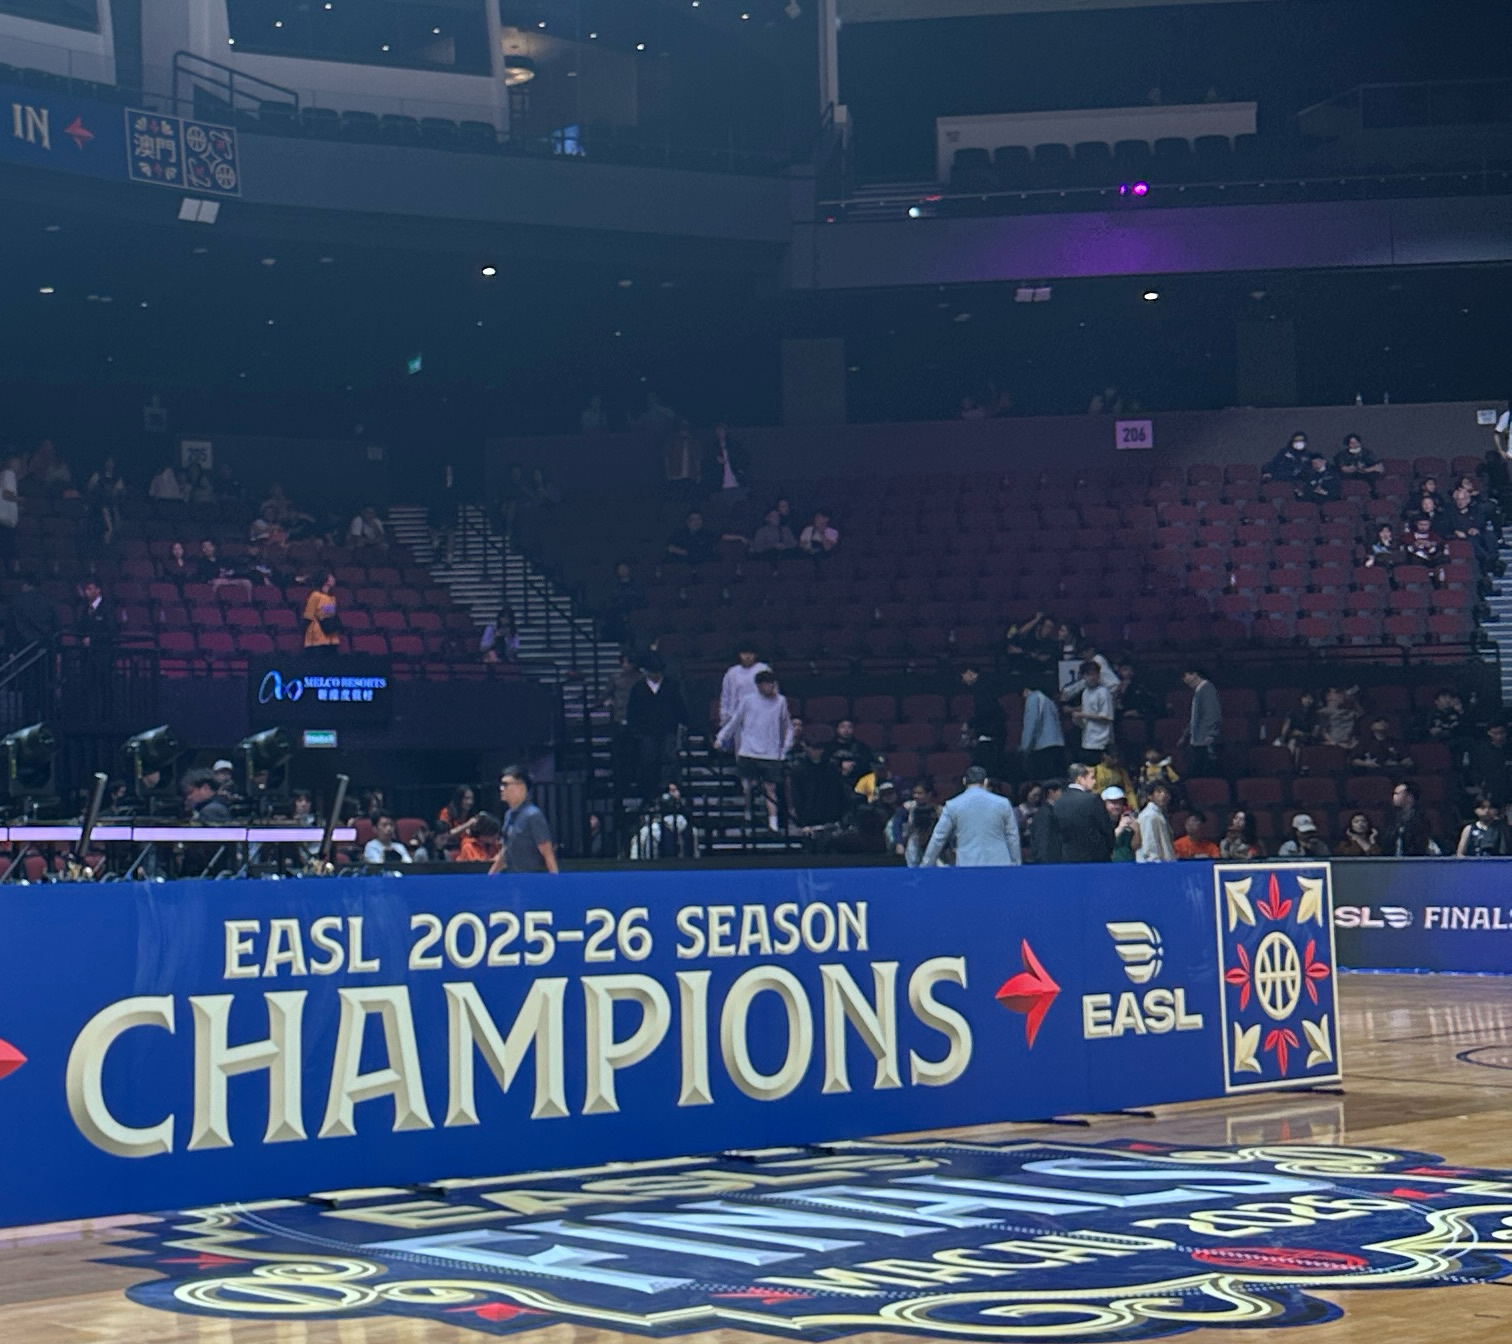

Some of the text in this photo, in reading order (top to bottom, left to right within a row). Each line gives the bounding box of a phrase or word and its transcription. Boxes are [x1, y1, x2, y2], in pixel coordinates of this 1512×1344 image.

[12, 103, 51, 150] IN
[134, 134, 176, 162] 澳門
[1122, 427, 1147, 443] 206
[224, 901, 869, 979] EASL 2025-26 SEASON
[1423, 906, 1512, 930] FINAL
[1082, 987, 1203, 1040] EASL
[65, 955, 973, 1159] CHAMPIONS
[320, 1170, 868, 1229] EASL
[361, 1157, 1336, 1294] FINALS
[756, 1195, 1409, 1296] MACAU 2026
